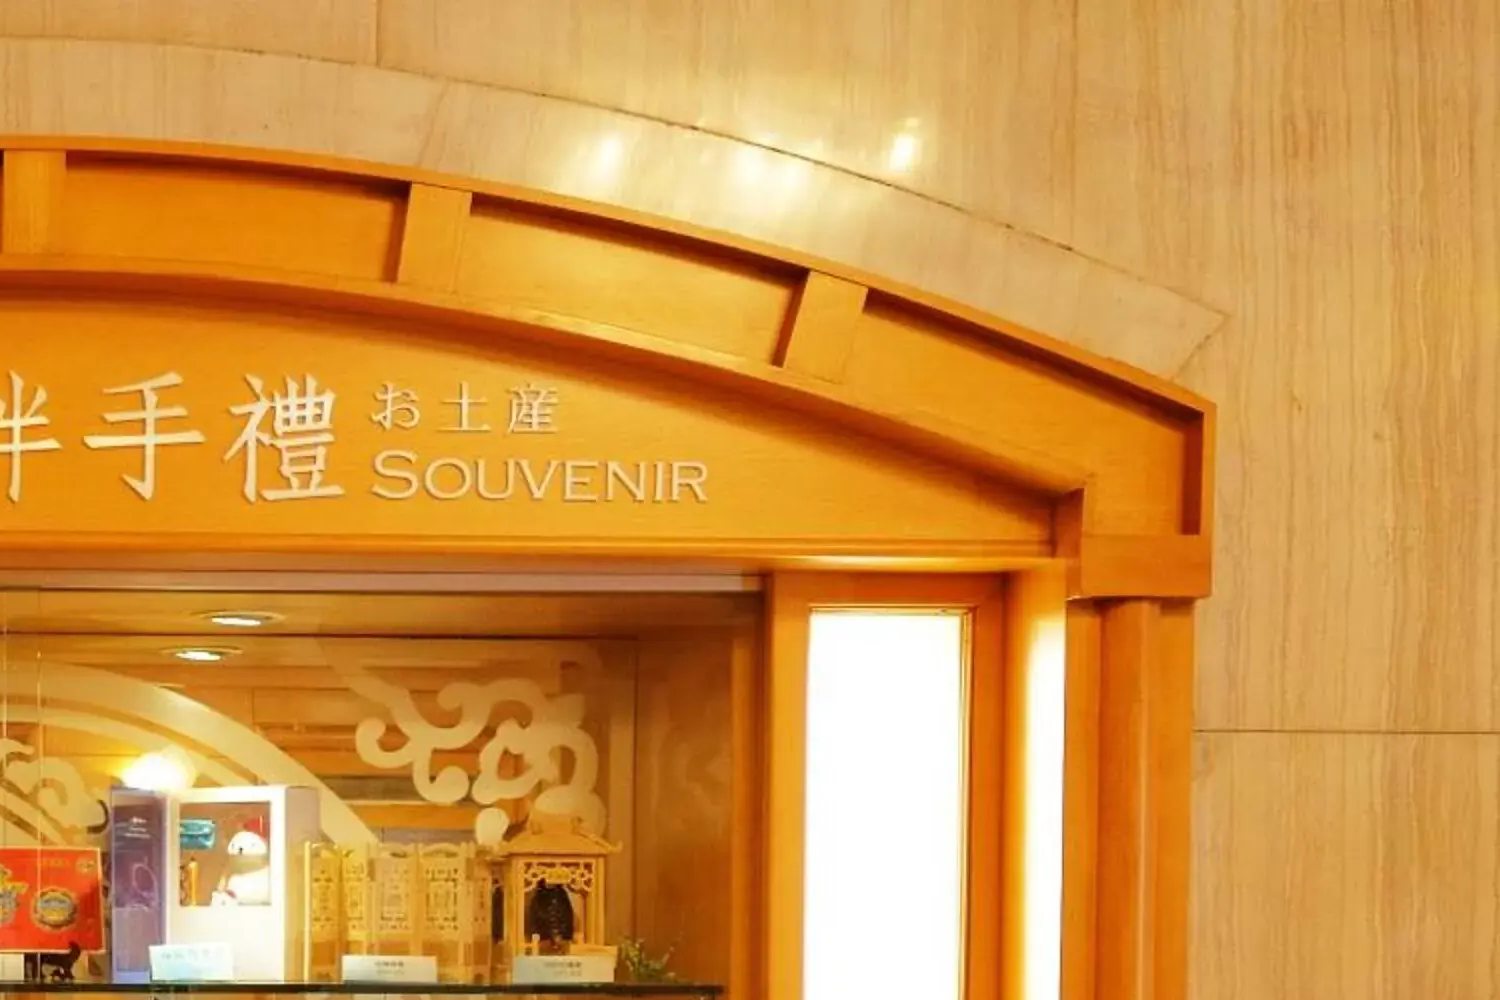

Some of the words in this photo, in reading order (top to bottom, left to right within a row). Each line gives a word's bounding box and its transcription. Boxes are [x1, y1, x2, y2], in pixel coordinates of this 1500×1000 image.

[370, 381, 558, 434] お土産
[370, 450, 709, 503] SOUVENIR
